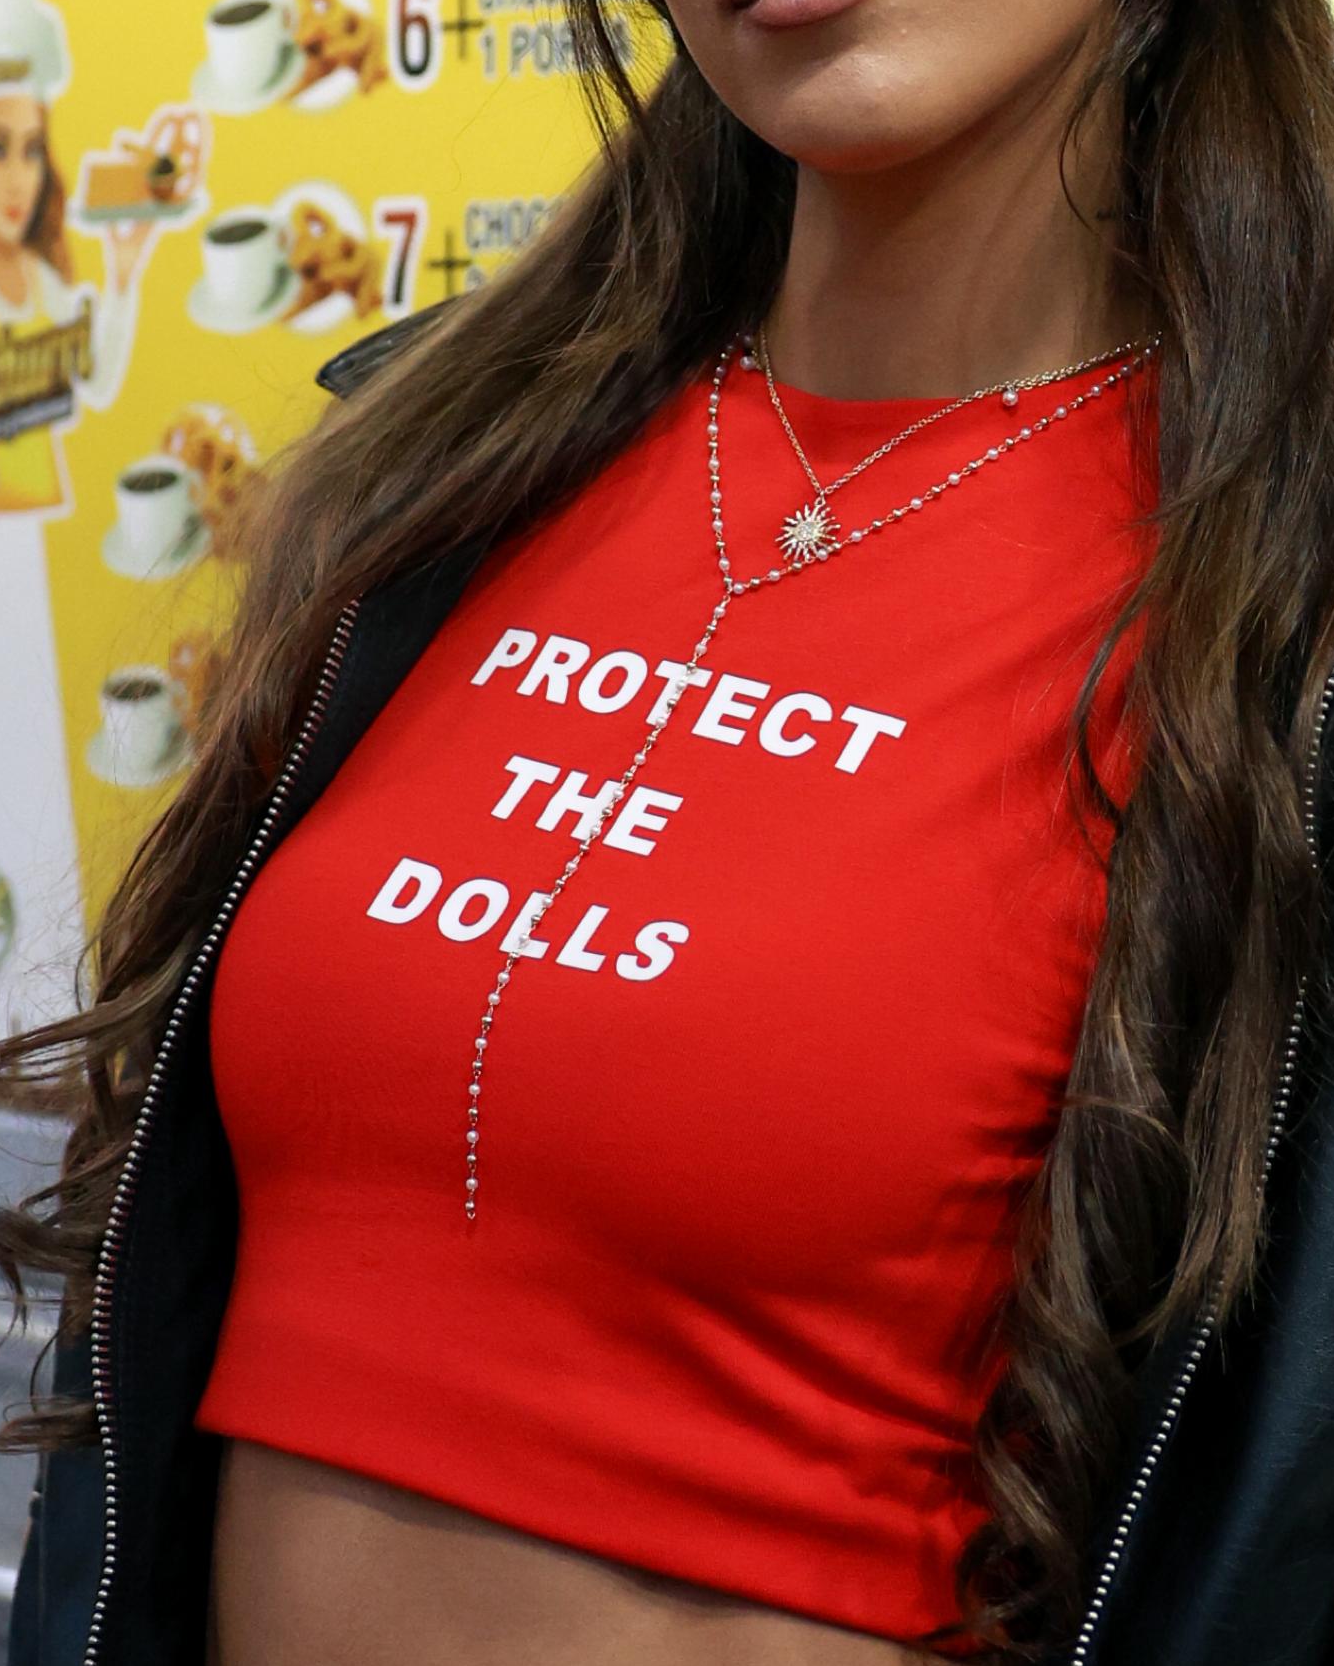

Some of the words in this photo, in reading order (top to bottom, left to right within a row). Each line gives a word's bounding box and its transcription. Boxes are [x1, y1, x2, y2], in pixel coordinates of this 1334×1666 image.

[381, 207, 421, 309] 7
[470, 627, 907, 774] PROTECT
[490, 754, 684, 857] THE
[366, 856, 690, 982] DOLLS
